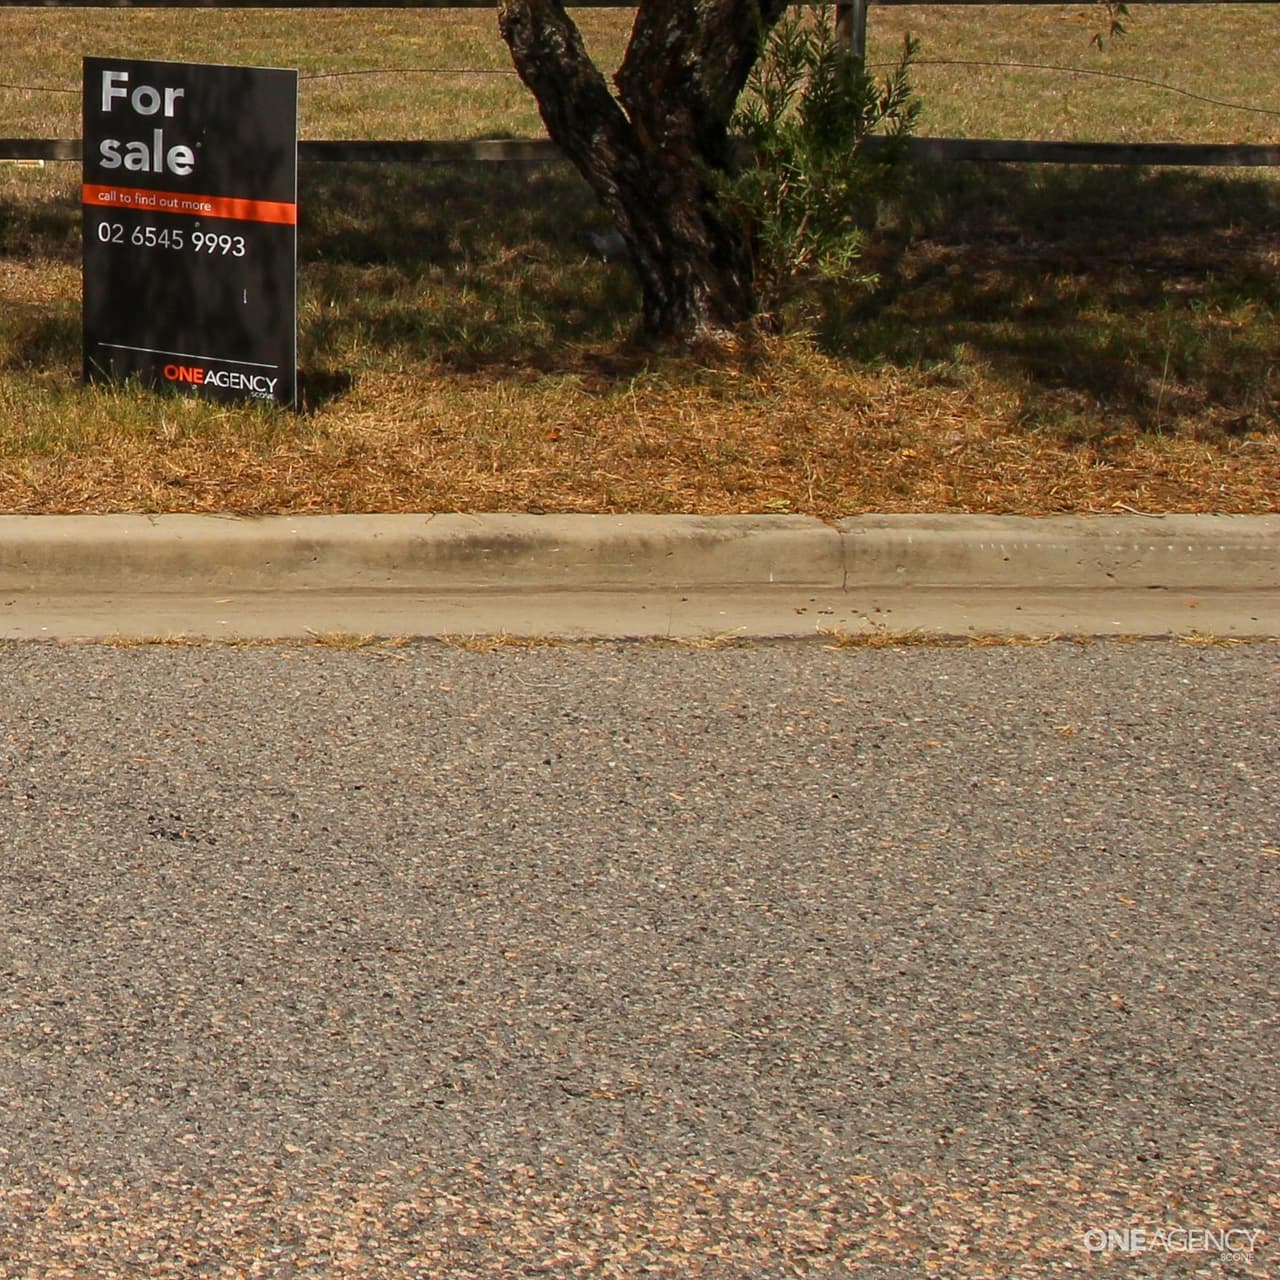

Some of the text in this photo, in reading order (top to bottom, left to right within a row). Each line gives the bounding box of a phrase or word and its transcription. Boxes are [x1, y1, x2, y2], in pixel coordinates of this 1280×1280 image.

[102, 70, 184, 117] For
[99, 128, 195, 176] sale
[98, 190, 212, 212] call to find out more
[98, 222, 246, 257] 02 6545 9993
